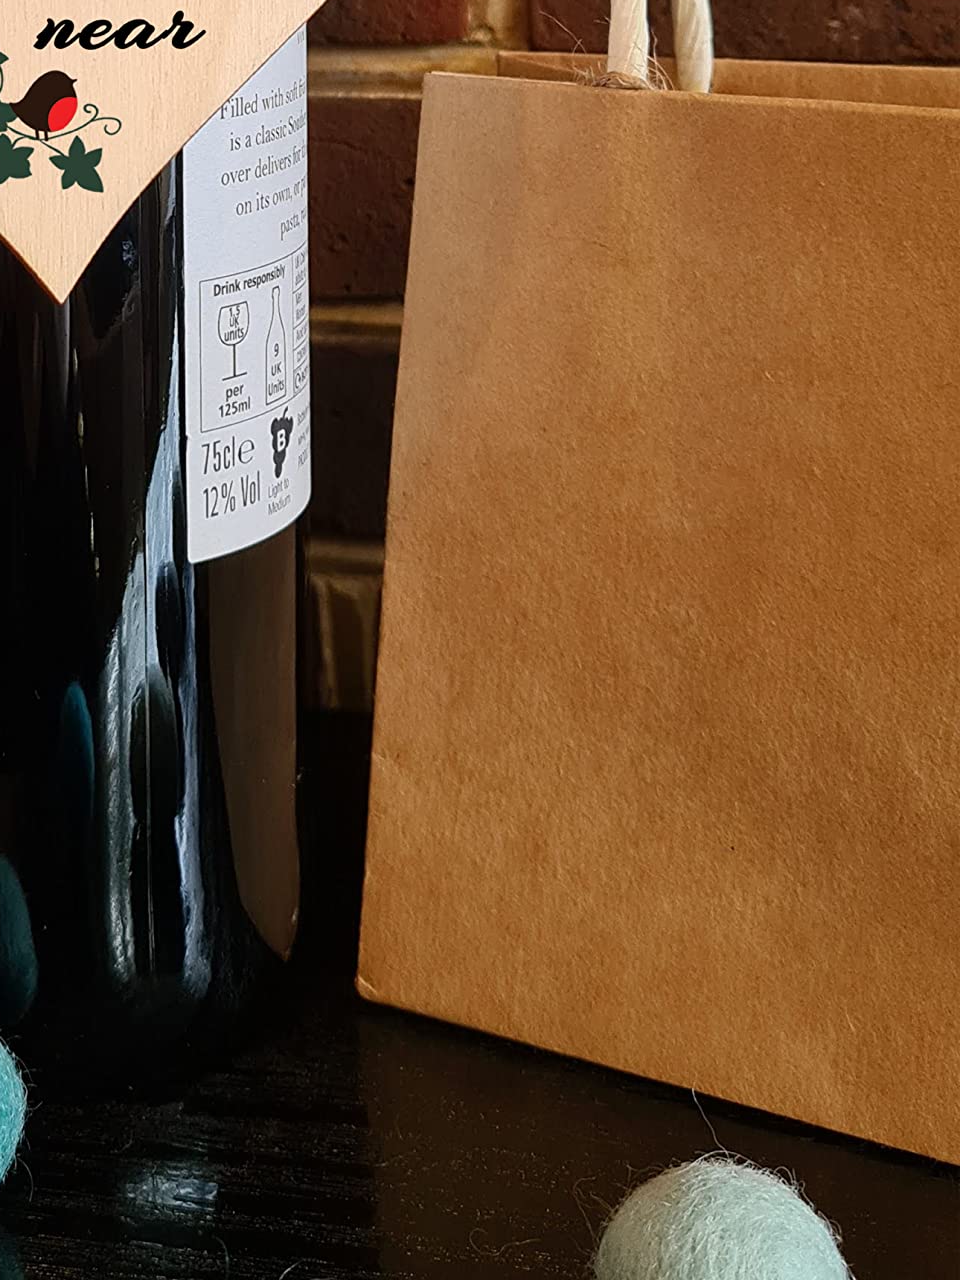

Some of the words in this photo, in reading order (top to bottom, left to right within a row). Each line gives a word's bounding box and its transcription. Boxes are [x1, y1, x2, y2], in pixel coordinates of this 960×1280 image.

[34, 11, 207, 51] near
[220, 93, 258, 120] Filled
[262, 87, 284, 111] with
[285, 81, 298, 104] soft
[230, 131, 241, 151] is
[245, 134, 252, 148] a
[255, 124, 287, 146] classic
[221, 167, 252, 186] over
[254, 155, 292, 179] delivers
[292, 145, 301, 165] for
[235, 200, 252, 216] on
[256, 191, 270, 211] its
[213, 279, 241, 297] Drink
[243, 264, 285, 290] responsibly
[229, 315, 240, 328] UK
[224, 327, 245, 342] units
[273, 343, 280, 358] 9
[271, 361, 282, 377] UK
[225, 384, 245, 403] per
[268, 378, 285, 397] Units
[218, 396, 251, 418] 125ml
[203, 480, 237, 519] 12%
[241, 470, 261, 507] Vol
